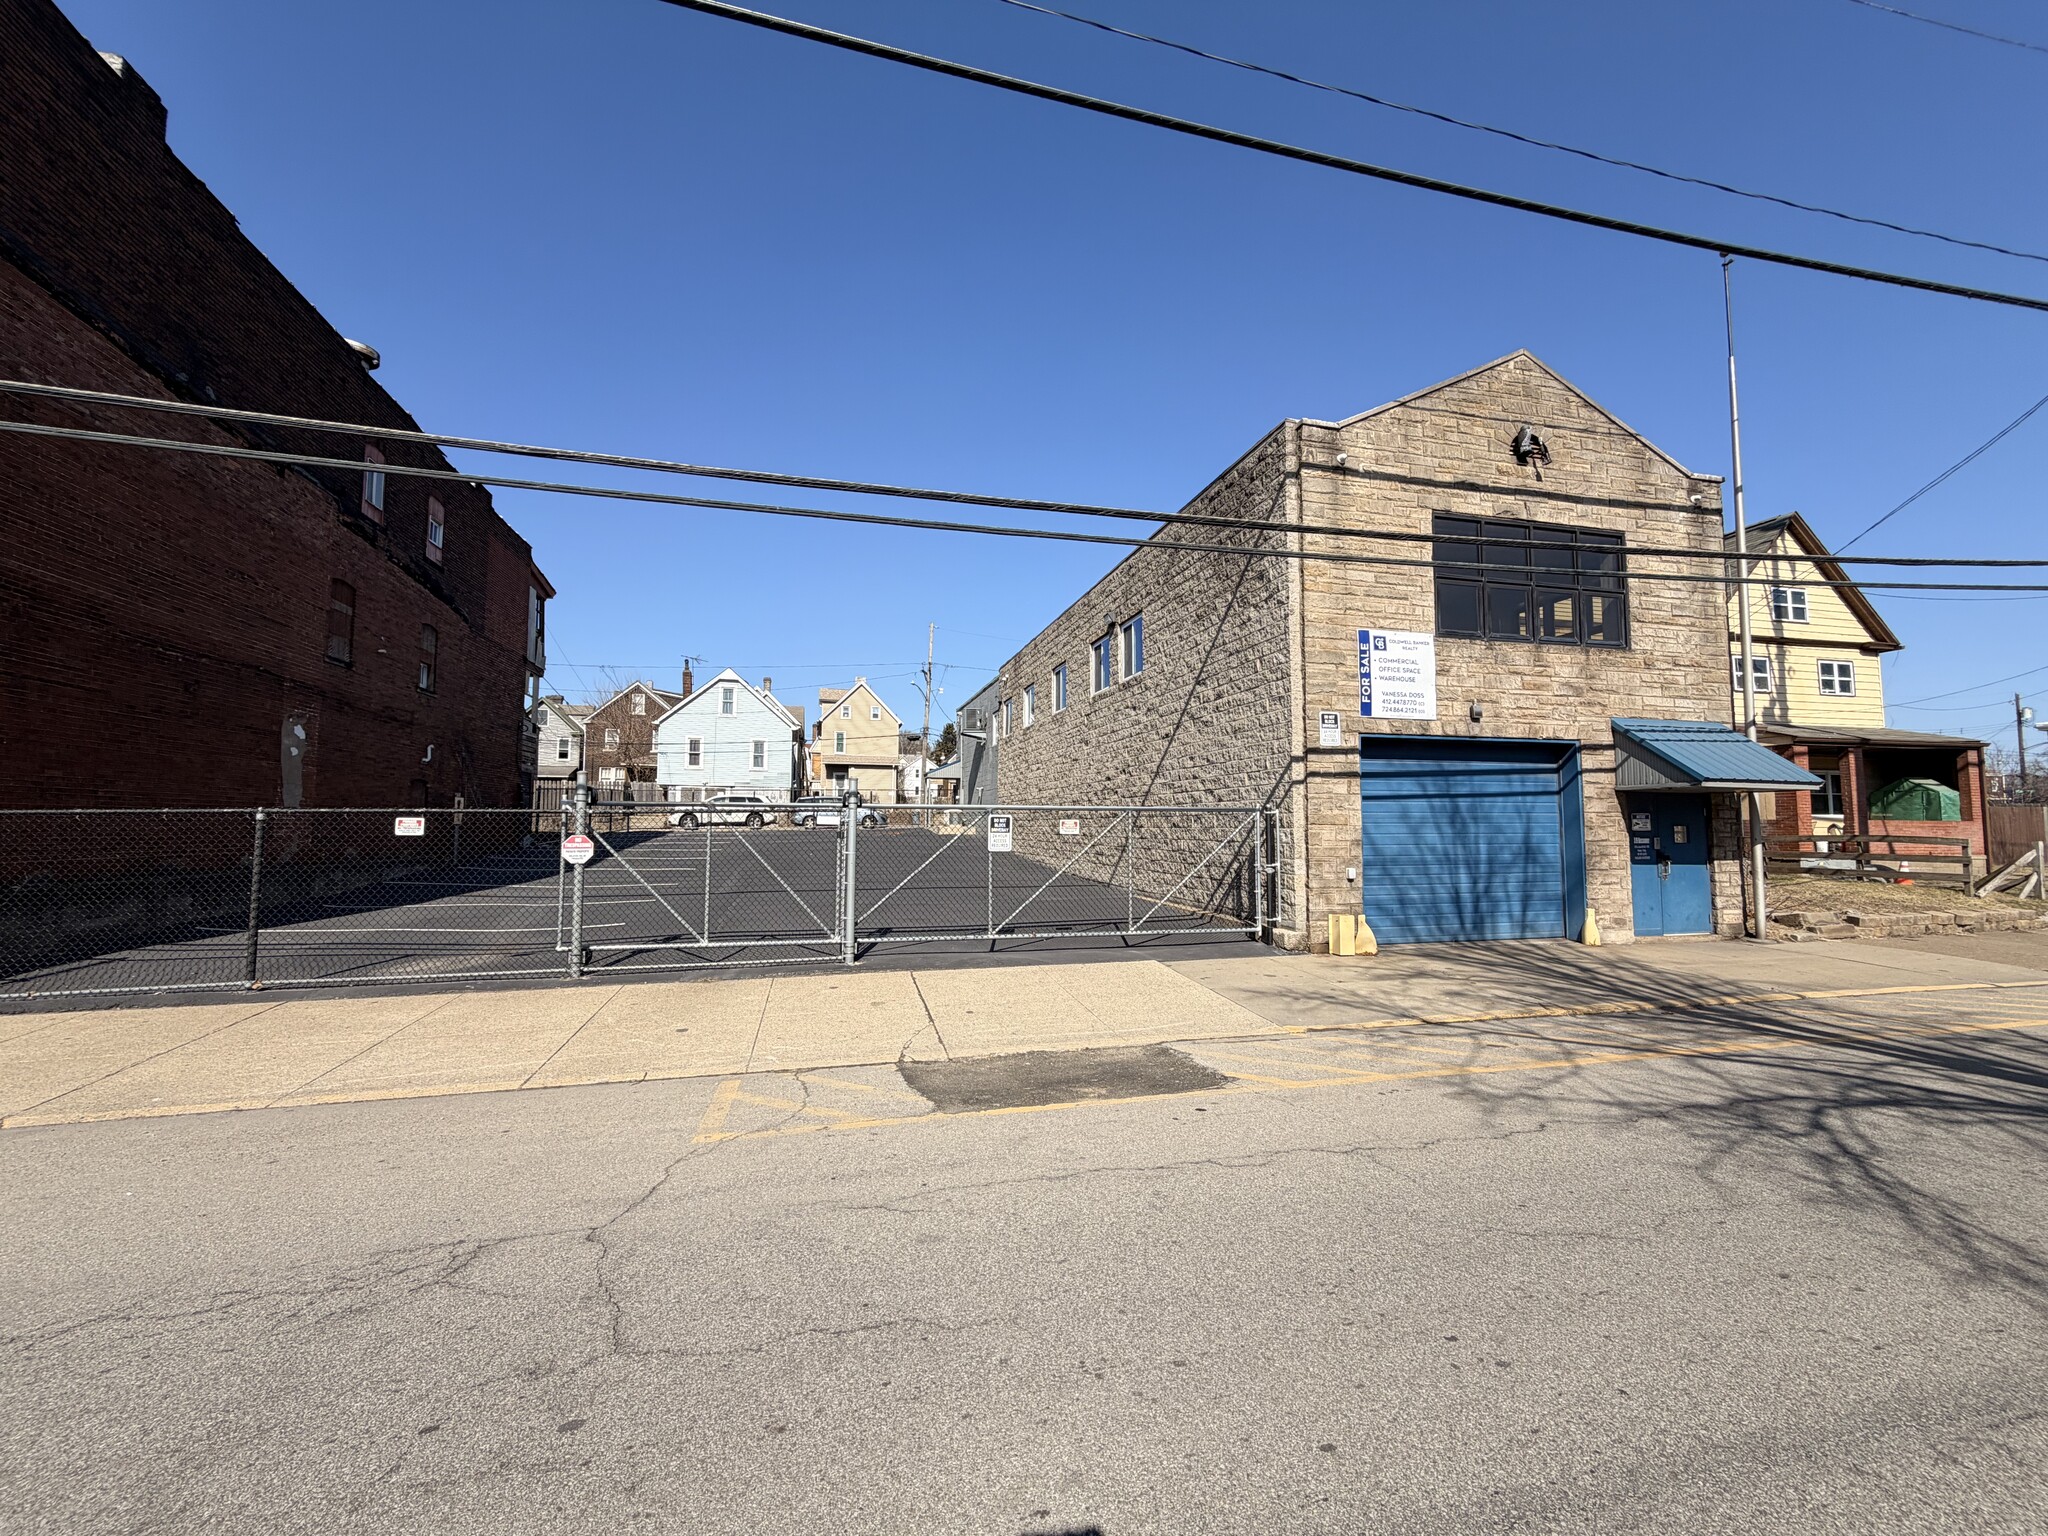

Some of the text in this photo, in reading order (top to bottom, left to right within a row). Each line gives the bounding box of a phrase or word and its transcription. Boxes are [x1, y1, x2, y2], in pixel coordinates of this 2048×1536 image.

[1360, 642, 1371, 703] FOR SALE
[1378, 657, 1419, 665] COMMERCIAL
